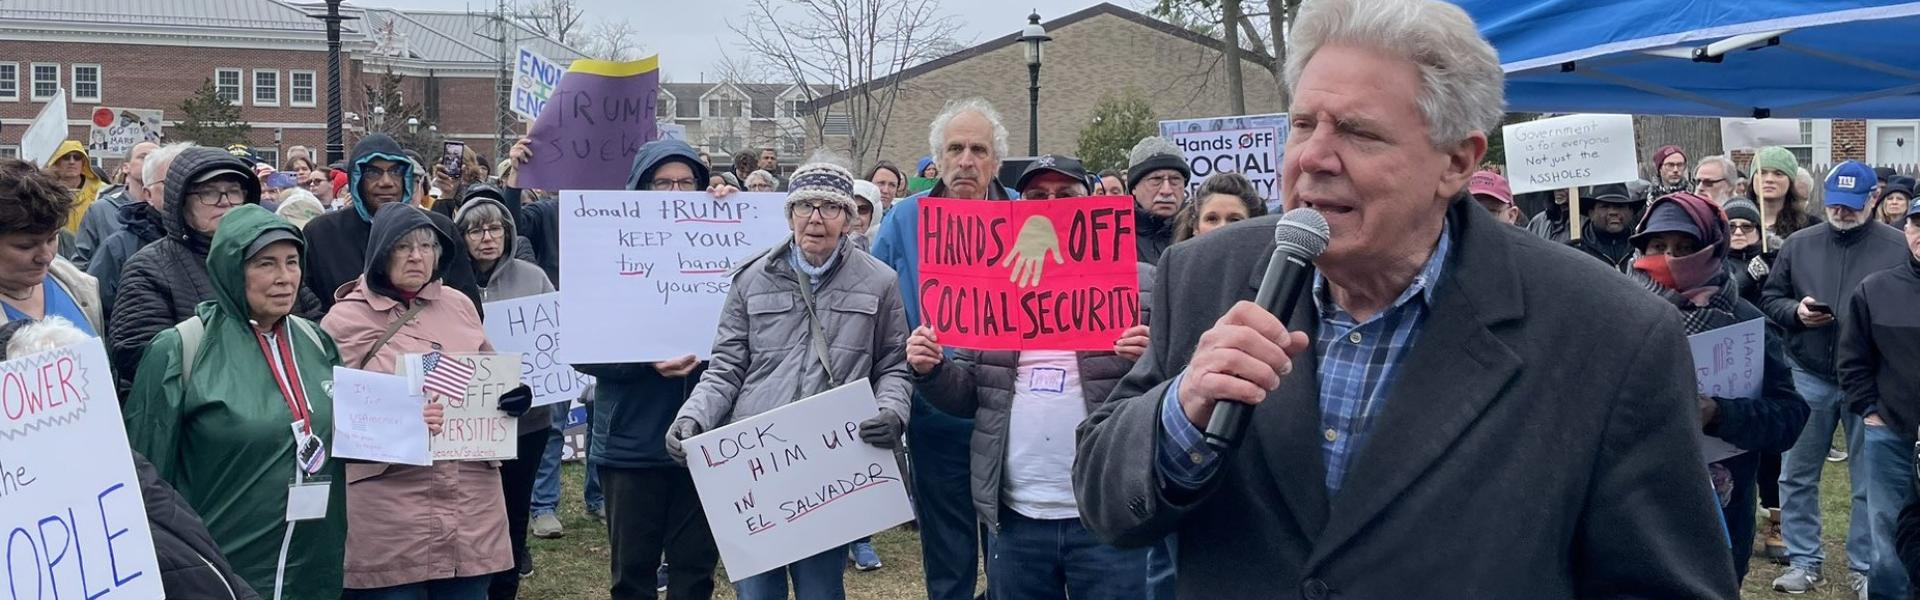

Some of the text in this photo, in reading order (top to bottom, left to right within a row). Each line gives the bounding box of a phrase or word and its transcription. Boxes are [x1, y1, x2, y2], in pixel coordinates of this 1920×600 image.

[555, 89, 657, 128] TRUMP
[109, 127, 124, 136] GO
[1175, 132, 1273, 152] Hands OFF
[1514, 120, 1599, 142] Government
[1538, 141, 1556, 150] for
[1561, 136, 1610, 149] everyone
[544, 132, 649, 163] SUCK
[1525, 151, 1599, 167] Not just the
[1184, 152, 1275, 177] OCIAL
[1529, 168, 1591, 184] ASSHOLES
[574, 194, 759, 220] donald tRUMP:
[618, 229, 751, 247] KEEP YOUR
[923, 205, 1133, 267] HANDS OFF
[616, 252, 737, 278] tiny hand
[920, 278, 1139, 339] SOCIAL SECURITY
[520, 370, 591, 398] ECUR
[434, 416, 507, 443] VERSITIES
[701, 422, 788, 467] LOCK
[748, 421, 858, 482] HIM UP
[0, 461, 36, 498] he
[734, 489, 756, 514] IN
[745, 463, 899, 533] EL SALVADOR
